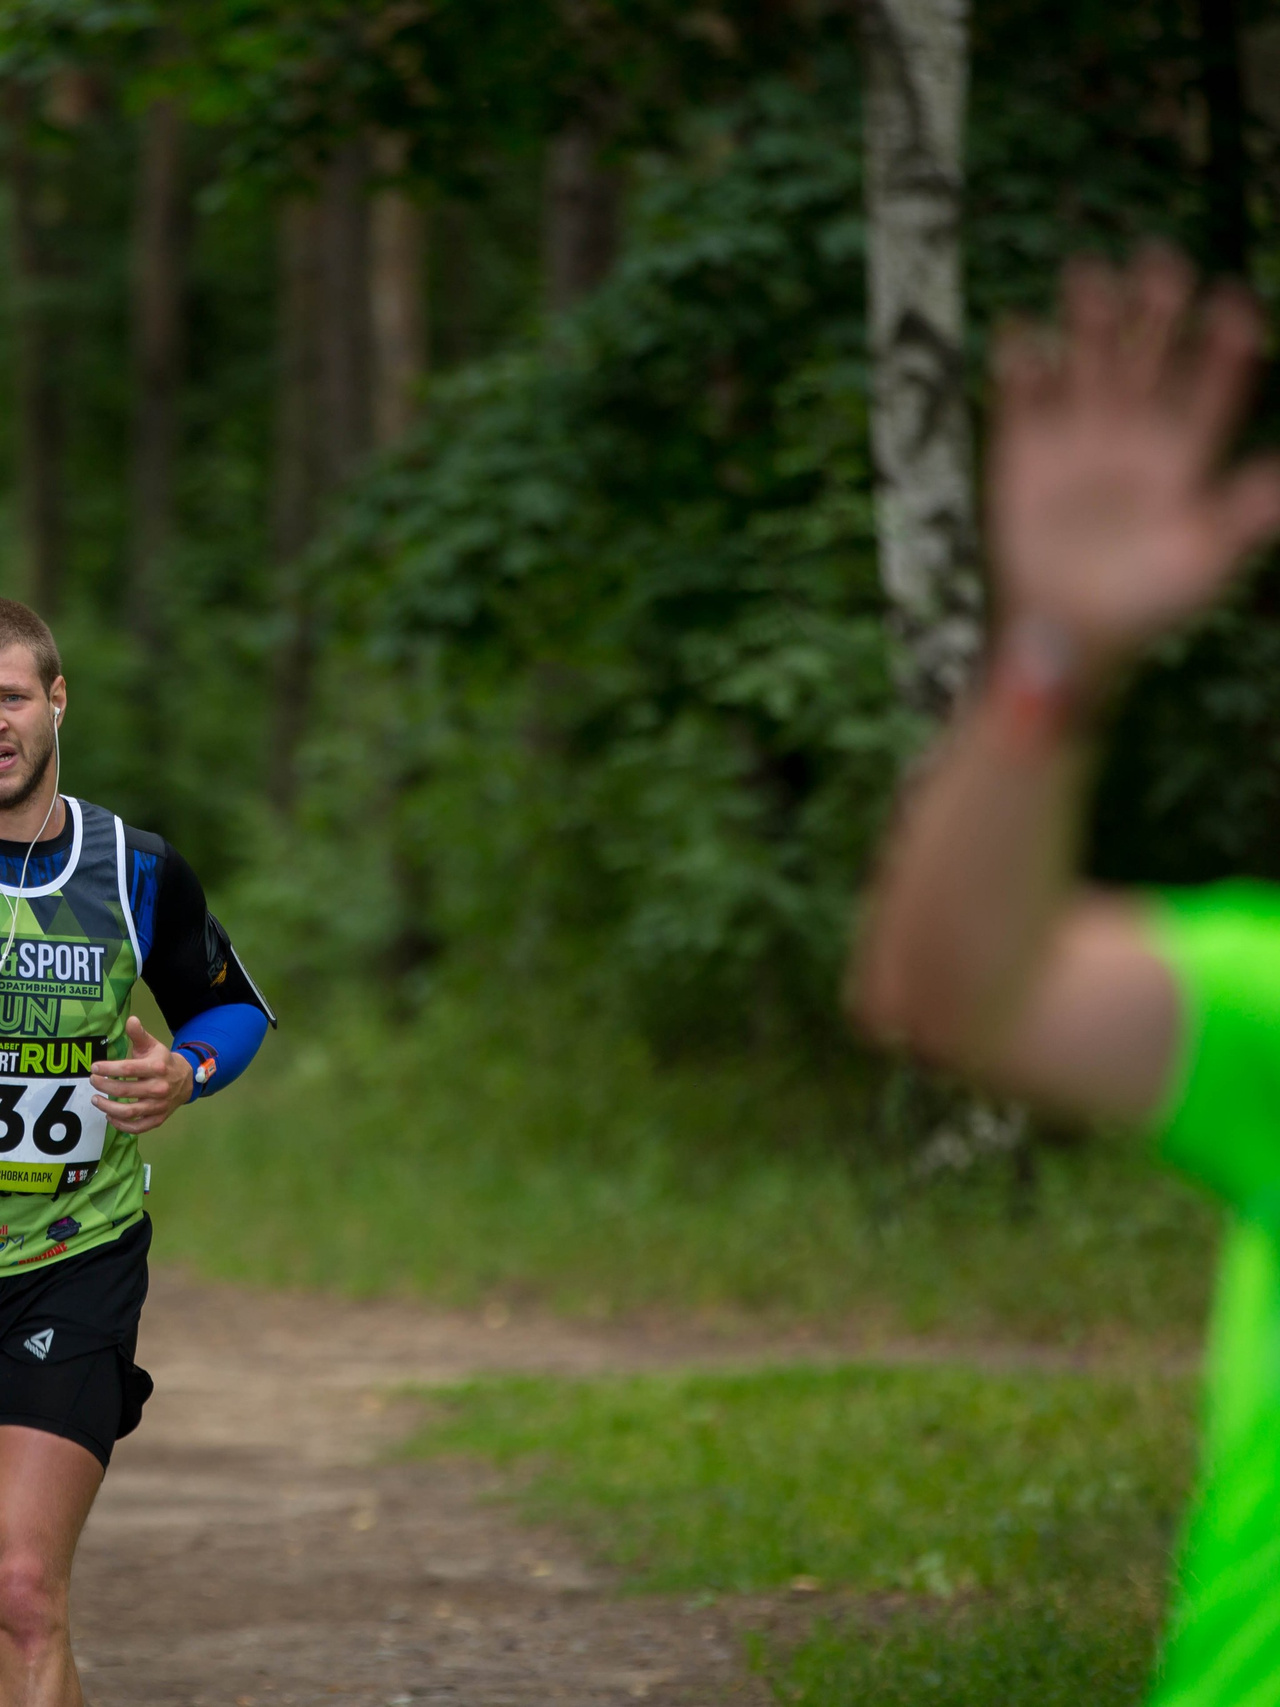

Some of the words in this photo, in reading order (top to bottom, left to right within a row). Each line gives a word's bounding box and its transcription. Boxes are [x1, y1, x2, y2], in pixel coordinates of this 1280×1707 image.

[69, 986, 98, 996] ЗАБЕГ
[20, 1042, 93, 1074] RUN
[30, 1172, 53, 1183] ПАРК
